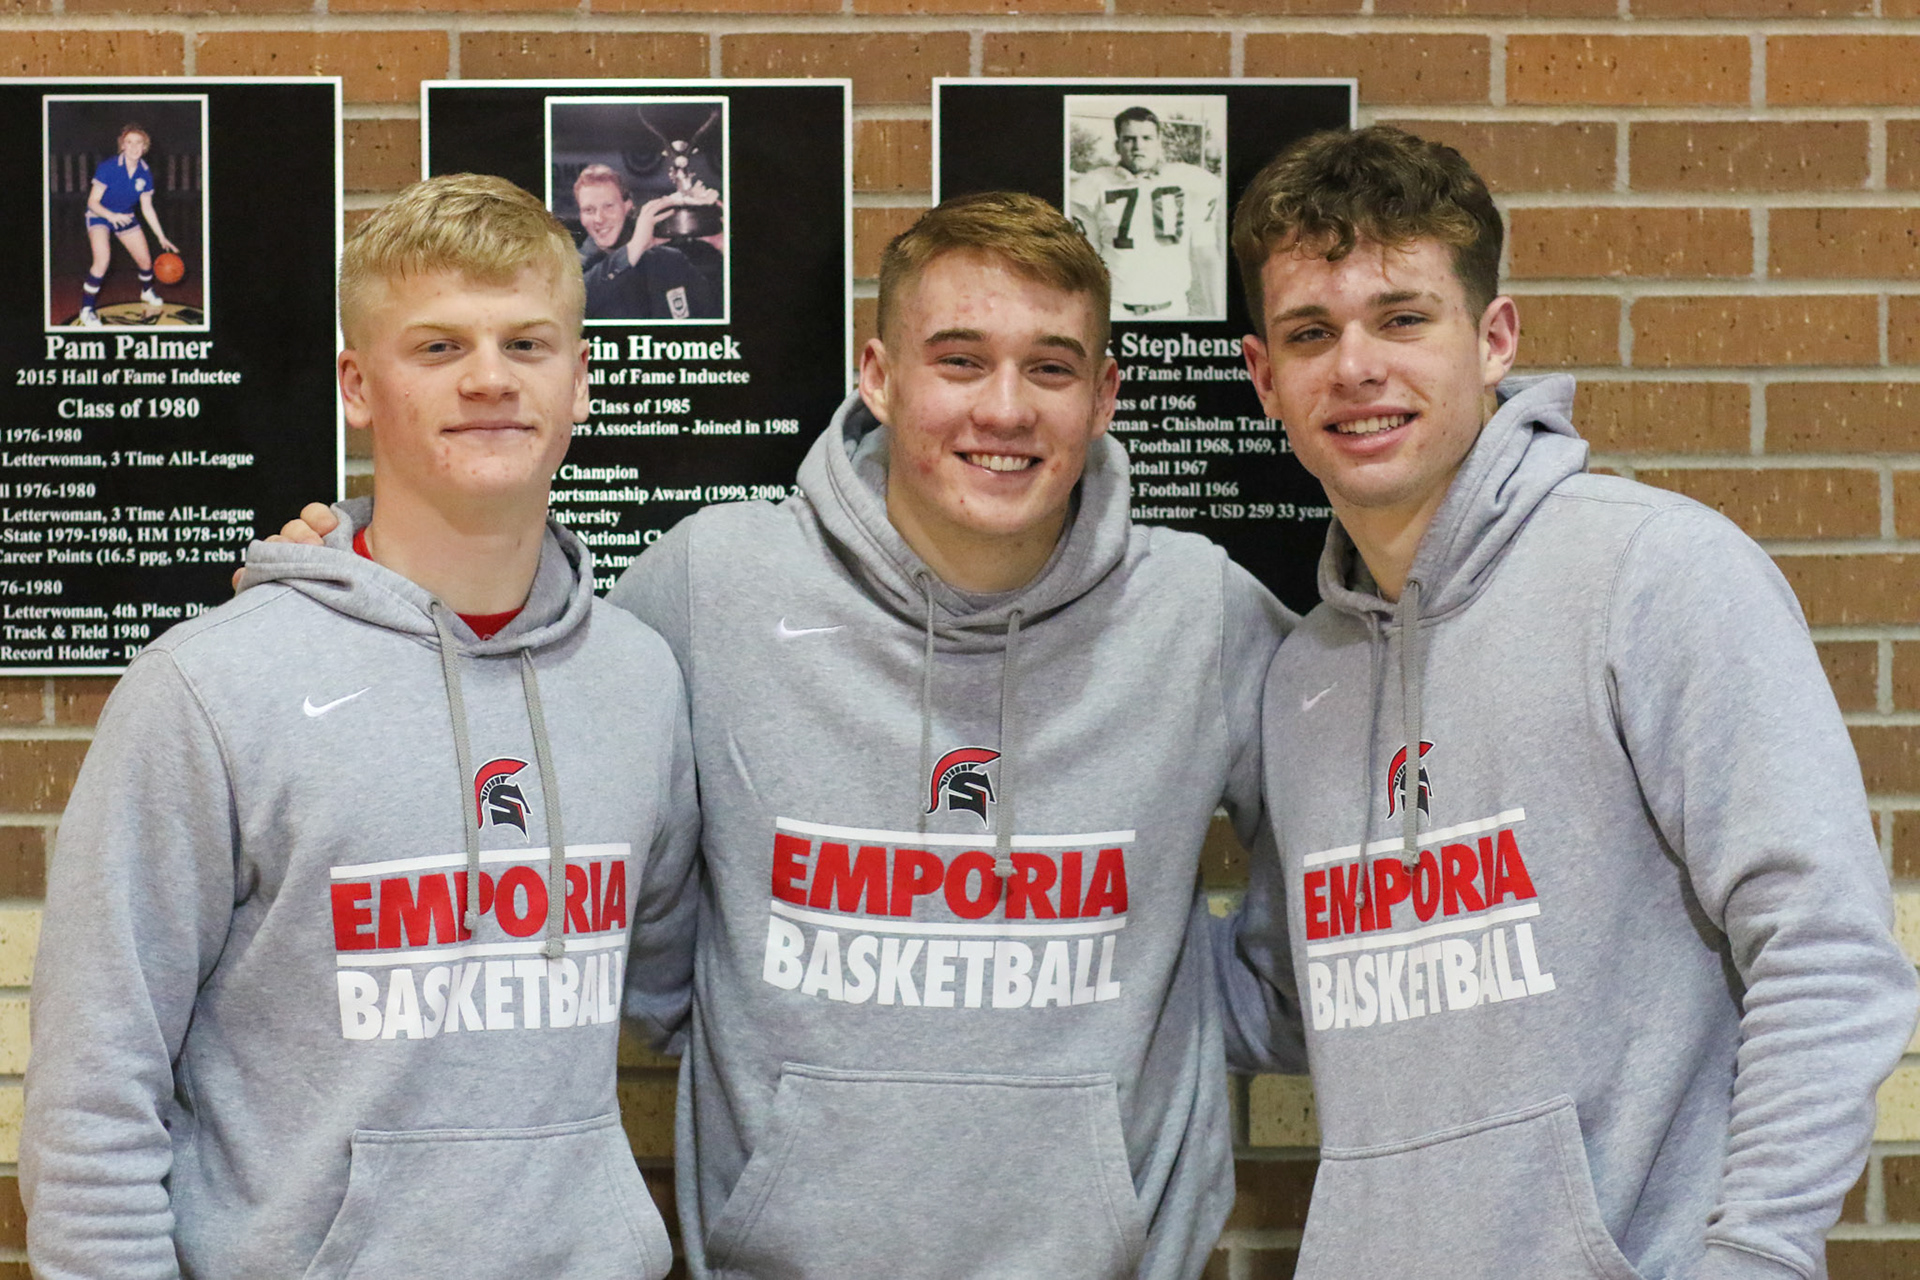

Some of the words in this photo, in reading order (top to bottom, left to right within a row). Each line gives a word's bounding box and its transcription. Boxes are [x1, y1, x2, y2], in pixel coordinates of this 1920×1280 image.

[45, 336, 106, 360] Pam
[115, 335, 213, 360] Palmer
[627, 335, 742, 361] Hromek
[16, 369, 57, 386] 2015
[61, 369, 98, 385] Hall
[102, 368, 120, 385] of
[123, 369, 168, 385] Fame
[171, 368, 242, 385] Inductee
[587, 368, 606, 385] all
[609, 368, 628, 385] of
[630, 368, 676, 385] Fame
[679, 368, 750, 384] Inductee
[1118, 365, 1135, 381] of
[1137, 366, 1183, 381] Fame
[58, 398, 115, 419] Class
[119, 398, 141, 419] of
[147, 397, 200, 419] 1980
[589, 398, 630, 414] Class
[633, 398, 651, 414] of
[653, 398, 691, 414] 1985
[1115, 398, 1136, 411] ass
[1140, 395, 1158, 411] of
[1160, 394, 1196, 411] 1966
[594, 420, 679, 436] Association
[691, 420, 742, 436] Joined
[745, 420, 761, 435] in
[763, 419, 799, 435] 1988
[1162, 416, 1235, 432] Chisholm
[1236, 416, 1277, 431] Trail
[6, 428, 82, 443] 1976-1980
[1129, 438, 1191, 454] Football
[1195, 438, 1235, 455] 1968,
[1237, 438, 1277, 455] 1969,
[2, 452, 108, 468] Letterwoman,
[110, 451, 121, 467] 3
[124, 451, 165, 466] Time
[168, 451, 255, 468] All-League
[1129, 460, 1170, 475] otball
[1173, 460, 1208, 475] 1967
[559, 464, 639, 484] Champion
[15, 483, 96, 499] 1976-1980
[548, 485, 649, 506] portsmanship
[651, 485, 702, 501] Award
[1138, 482, 1201, 497] Football
[1204, 482, 1239, 497] 1966
[2, 507, 108, 523] Letterwoman,
[111, 506, 121, 521] 3
[125, 506, 165, 521] Time
[168, 506, 255, 523] All-League
[1210, 504, 1245, 519] USD
[1248, 504, 1275, 519] 259
[1277, 503, 1295, 518] 33
[47, 528, 133, 544] 1979-1980,
[137, 528, 169, 543] HM
[174, 527, 255, 542] 1978-1979
[576, 530, 641, 546] National
[47, 548, 93, 564] Points
[96, 548, 136, 566] (16.5
[139, 552, 172, 566] ppg,
[176, 548, 200, 562] 9.2
[204, 547, 238, 562] rebs
[3, 604, 109, 620] Letterwoman,
[112, 603, 137, 618] 4th
[141, 603, 181, 618] Place
[3, 624, 48, 640] Track
[51, 624, 67, 640] &
[70, 624, 109, 640] Field
[112, 624, 150, 639] 1980
[0, 644, 54, 661] Record
[58, 644, 110, 660] Holder
[771, 832, 1129, 920] EMPORIA
[1303, 828, 1538, 941] EMPORIA
[330, 860, 627, 951] EMPORIA
[762, 914, 1121, 1009] BASKETBALL
[1308, 922, 1557, 1031] BASKETBALL
[336, 950, 623, 1041] BASKETBALL
